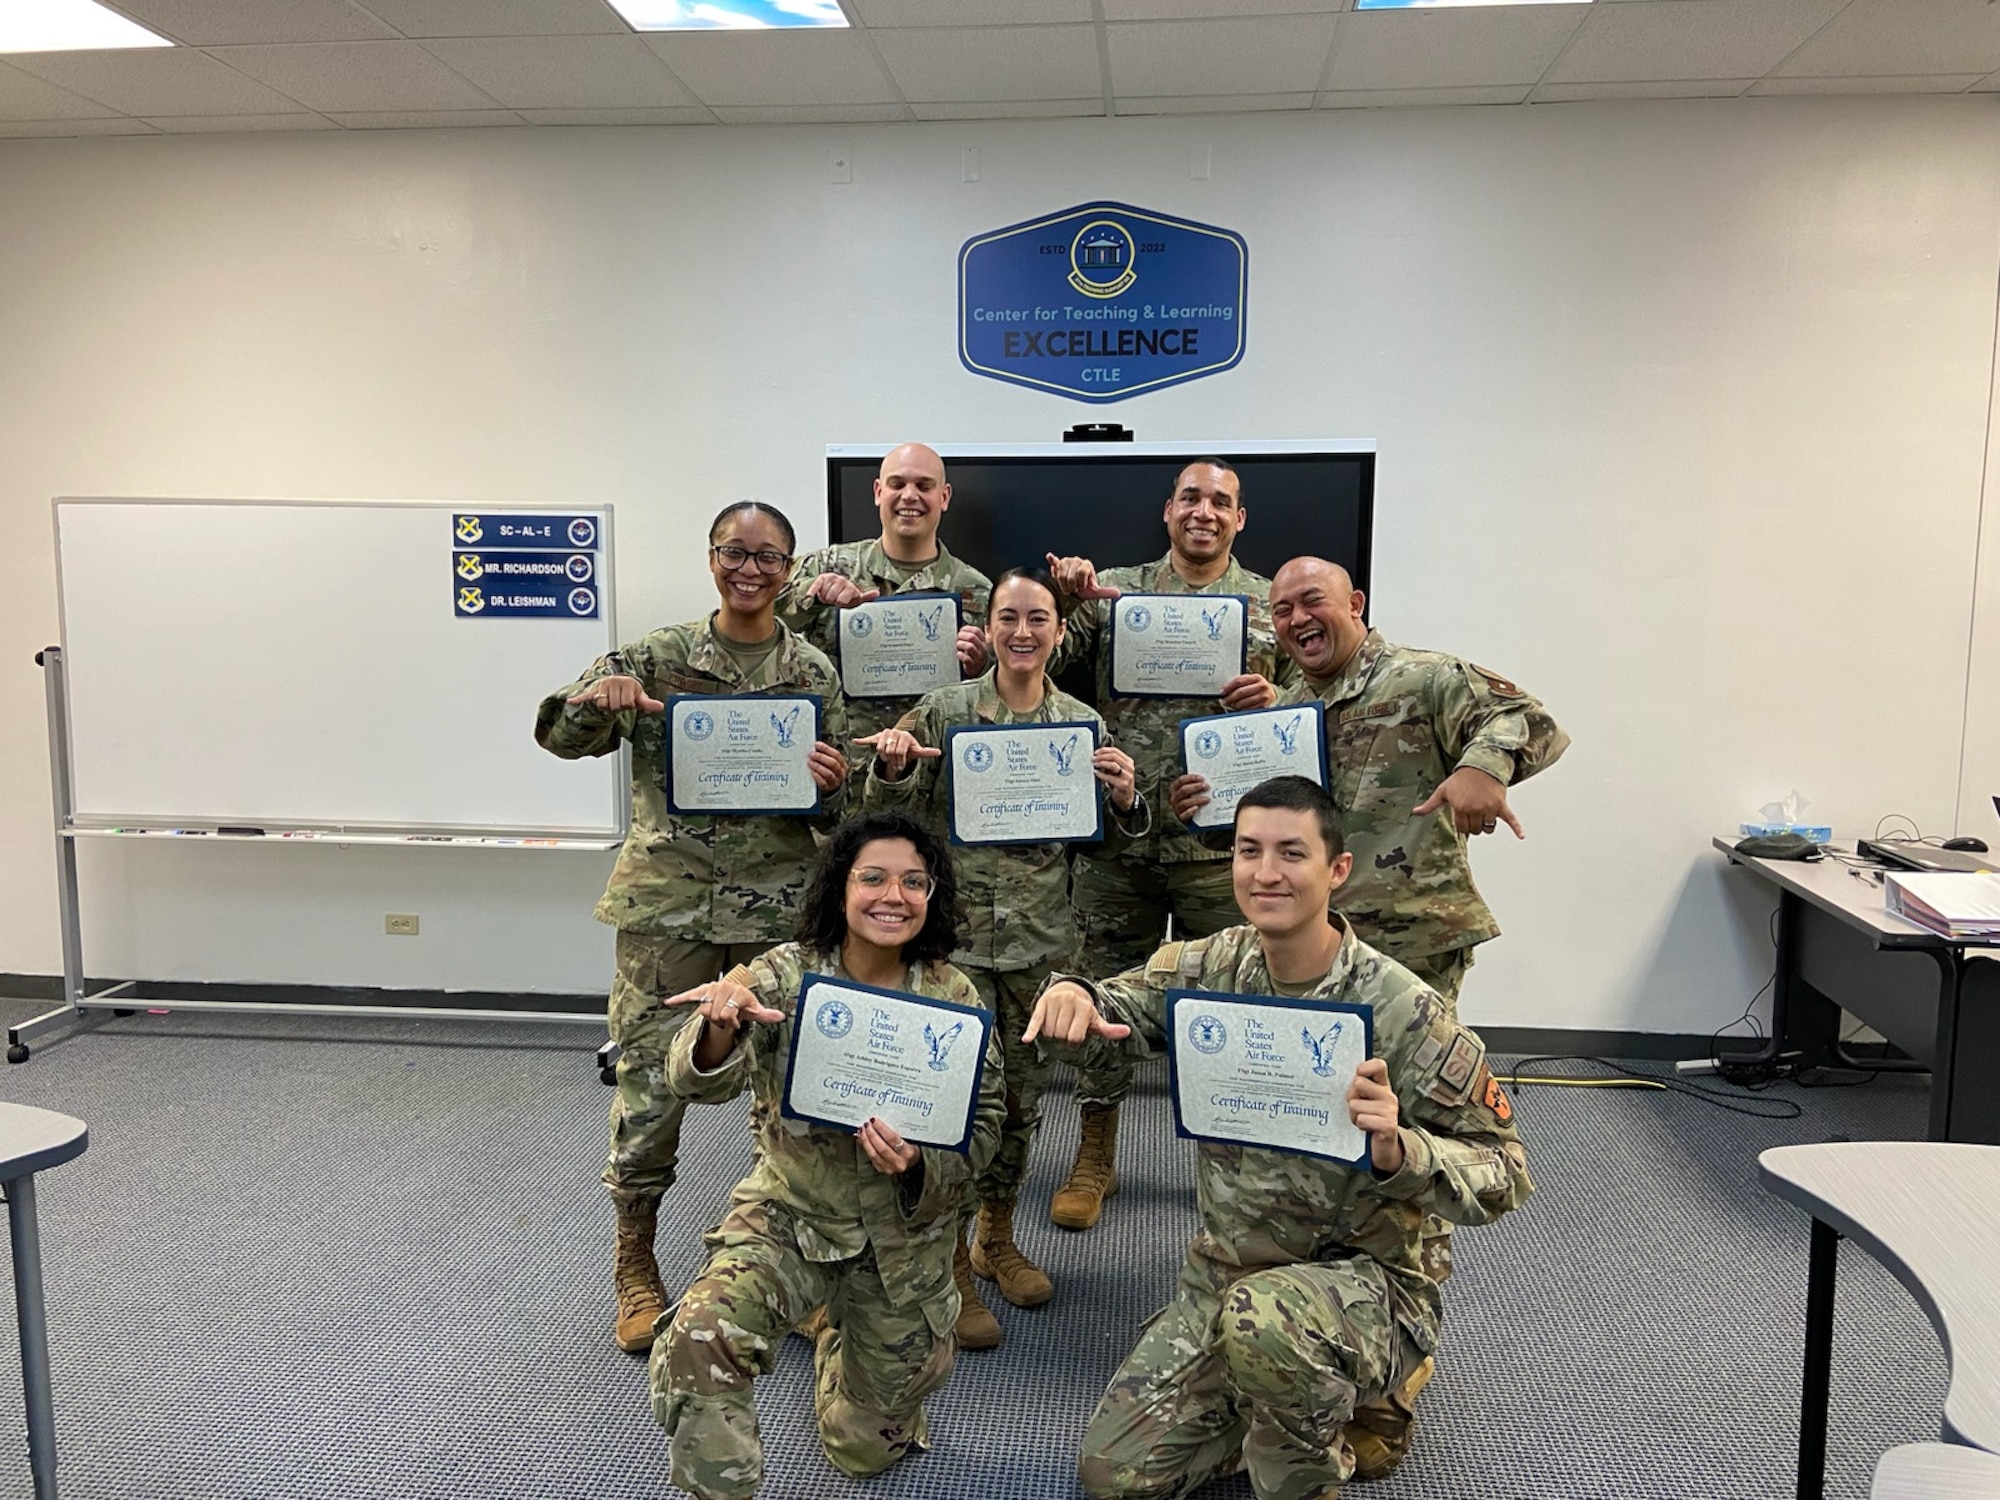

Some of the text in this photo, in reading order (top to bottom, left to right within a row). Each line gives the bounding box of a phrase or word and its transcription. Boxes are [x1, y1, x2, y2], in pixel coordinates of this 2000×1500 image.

[1039, 246, 1066, 255] ESTD
[1140, 243, 1166, 252] 2022
[973, 304, 1233, 322] Center for Teaching & Learning
[1004, 329, 1198, 357] EXCELLENCE
[1081, 368, 1120, 382] CTLE
[500, 526, 514, 536] SC
[522, 526, 535, 536] AL
[544, 526, 551, 536] E
[485, 563, 564, 575] MR. RICHARDSON
[491, 596, 556, 607] DR. LEISHMAN
[862, 662, 936, 677] Certificate of Training
[1136, 660, 1216, 676] Certificate of Training
[1234, 732, 1254, 740] United
[1006, 740, 1021, 748] The
[1246, 746, 1262, 754] Force
[698, 770, 788, 788] Certificate of Training
[980, 799, 1069, 818] Certificate of Training
[872, 1008, 890, 1020] The
[870, 1019, 898, 1032] United
[1244, 1018, 1264, 1028] The
[868, 1029, 894, 1042] States
[1244, 1028, 1274, 1040] United
[866, 1040, 904, 1054] Air Force
[1245, 1040, 1272, 1050] States
[1245, 1050, 1285, 1062] Air Force
[823, 1076, 934, 1116] Certificate of Training
[1210, 1093, 1330, 1126] Certificate of Training
